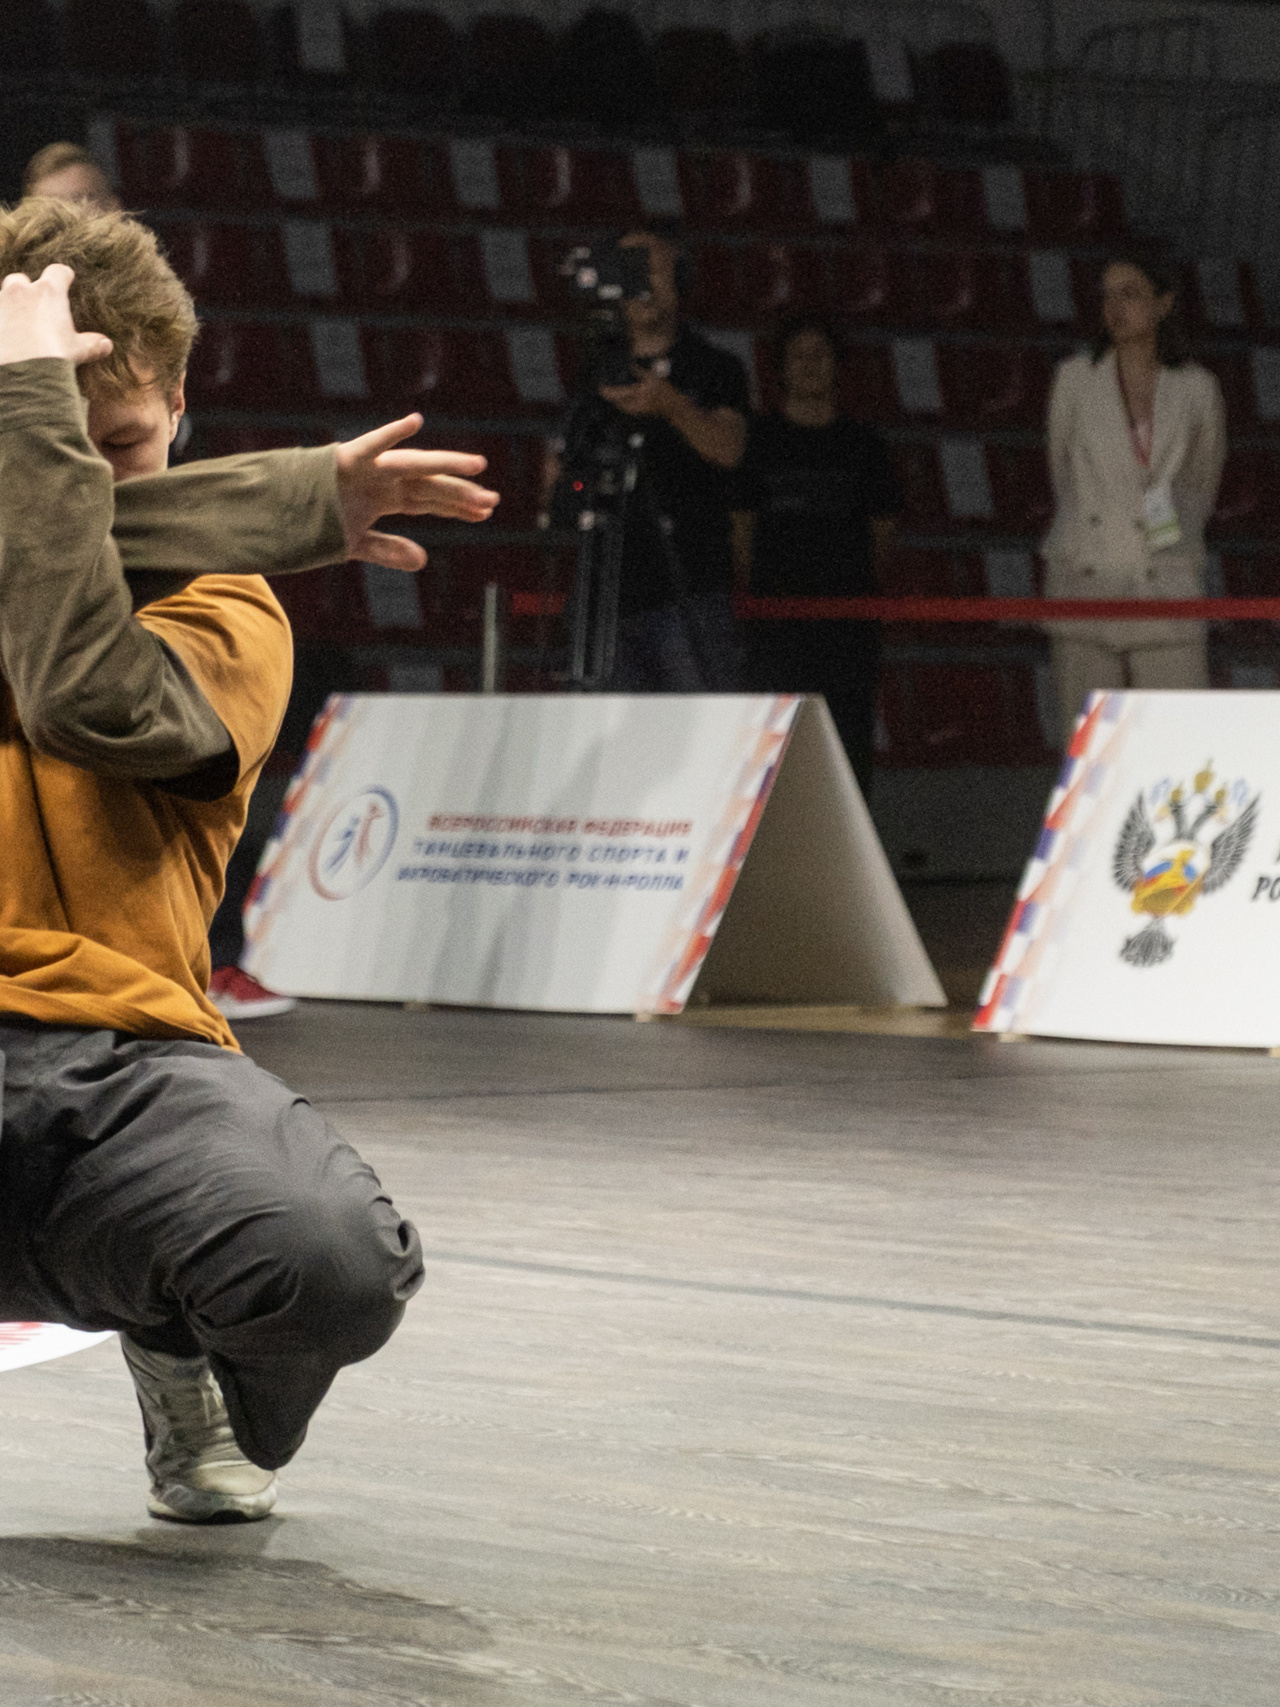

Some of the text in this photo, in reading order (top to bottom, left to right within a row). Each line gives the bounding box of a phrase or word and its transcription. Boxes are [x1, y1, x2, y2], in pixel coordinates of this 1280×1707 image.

[428, 814, 692, 838] ВСЕРОССИЙСКАЯ ФЕДЕРАЦИЯ
[415, 841, 690, 864] ТАНЦЕВАЛЬНОГО СПОРТА И
[398, 867, 558, 887] АКРОБАТИЧЕСКОГО
